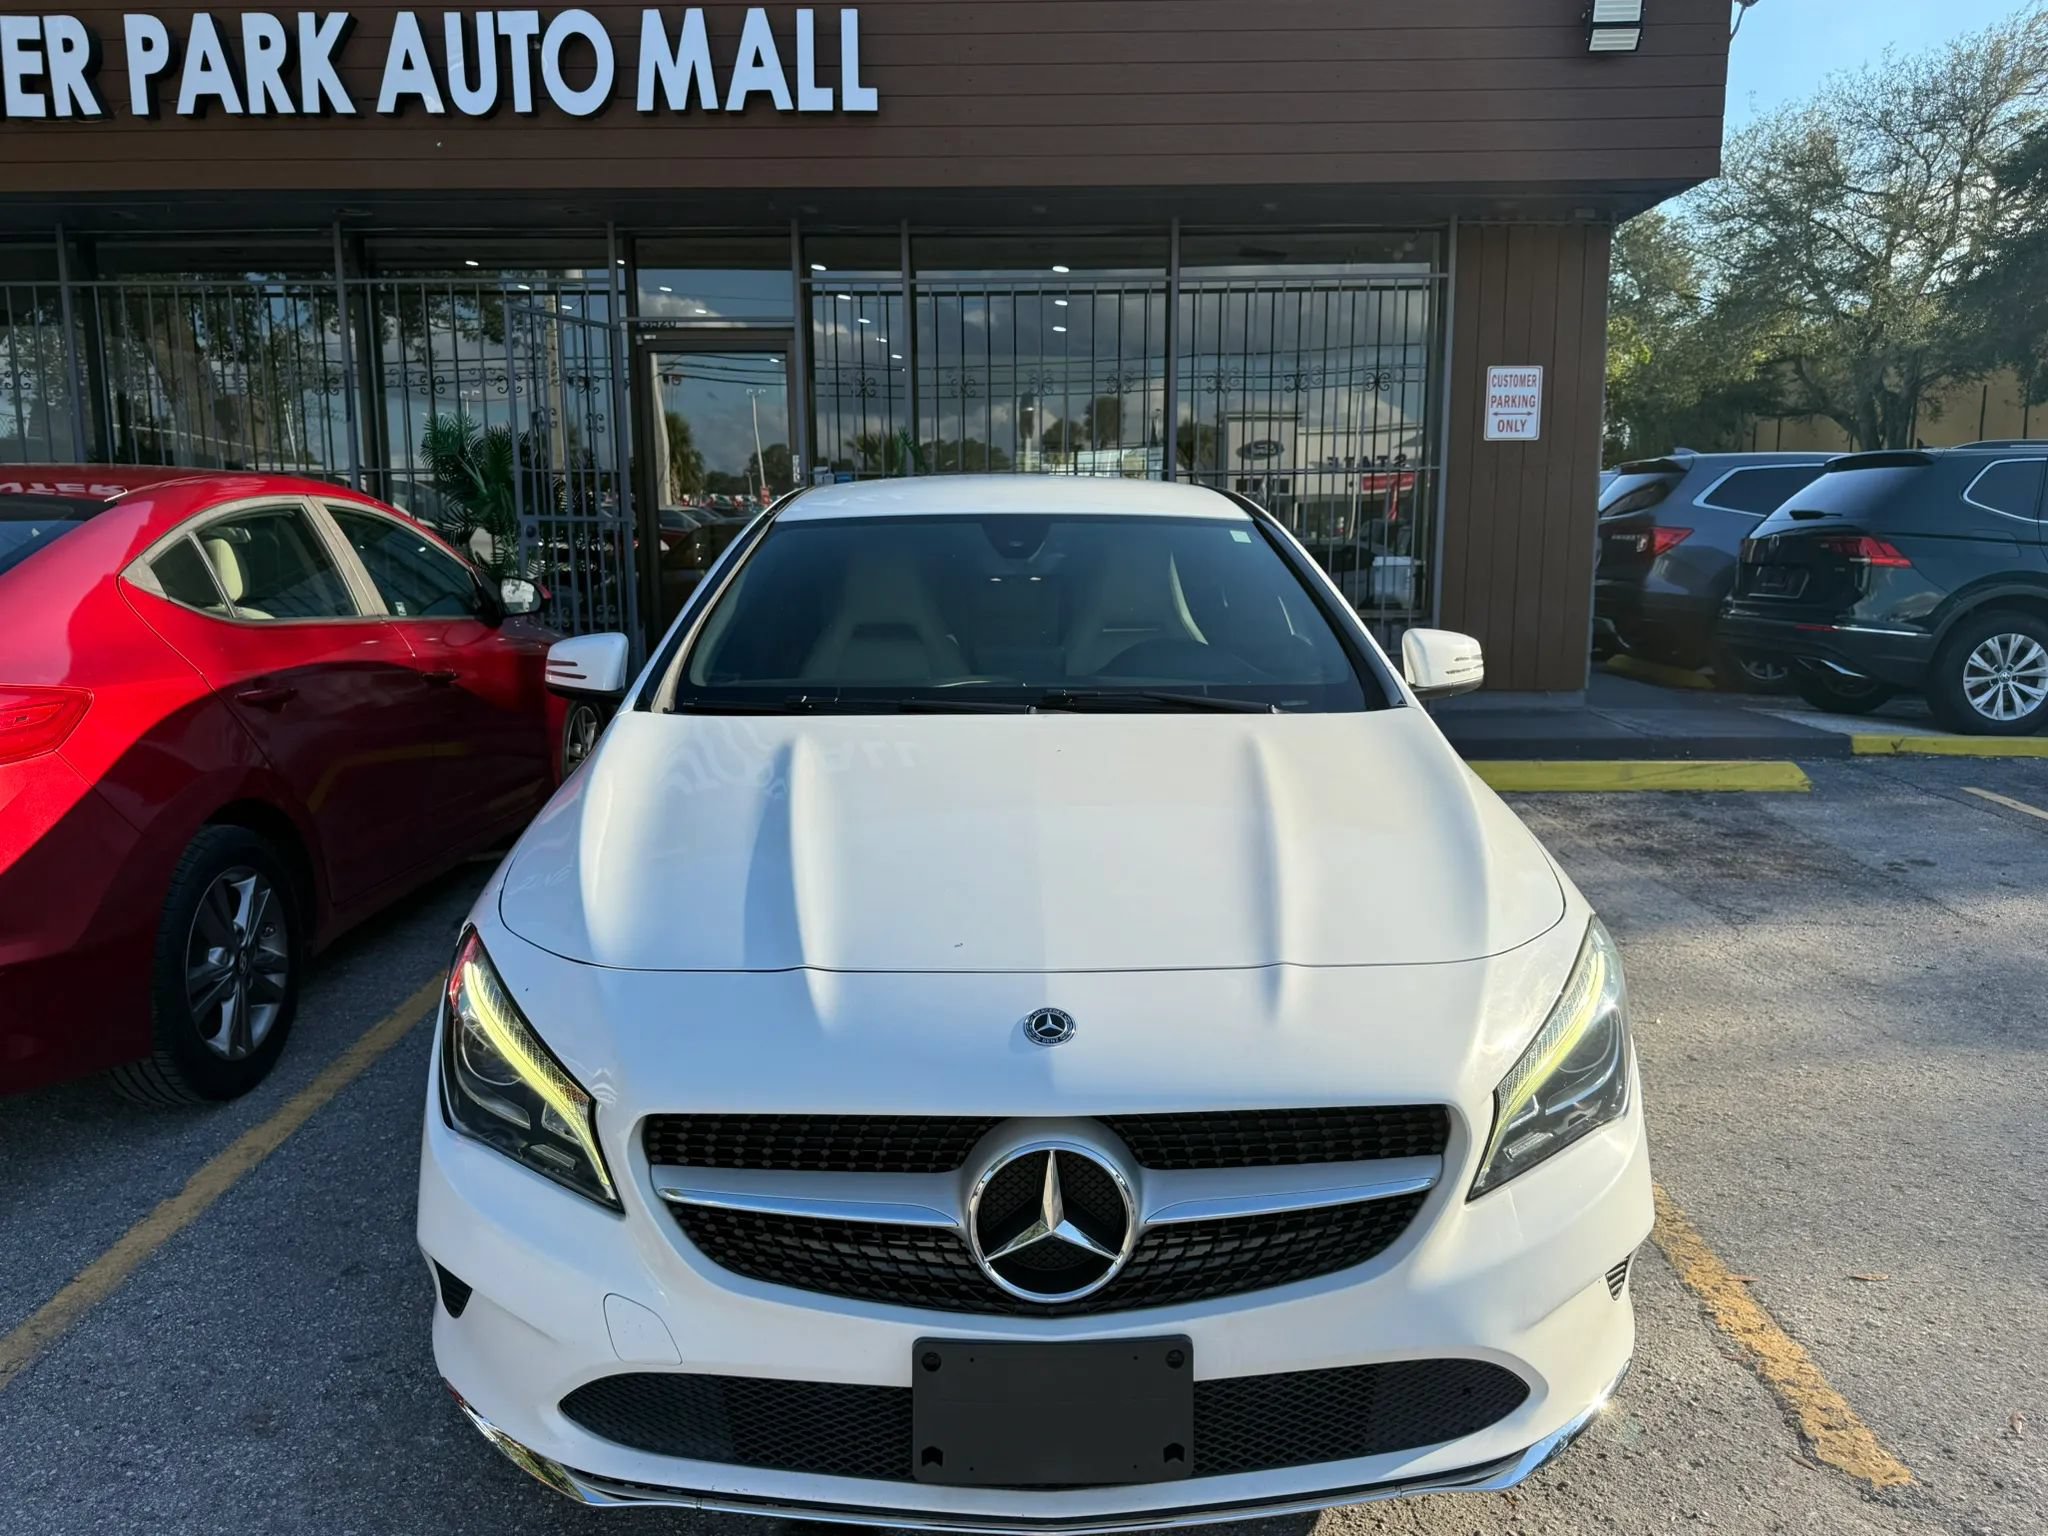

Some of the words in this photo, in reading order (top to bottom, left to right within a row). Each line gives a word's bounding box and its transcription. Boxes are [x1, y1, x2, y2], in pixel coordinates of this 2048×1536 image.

[0, 15, 102, 118] ER
[123, 11, 357, 115] PARK
[376, 8, 615, 116] AUTO
[636, 7, 878, 112] MALL
[1491, 374, 1537, 388] CUSTOMER
[1490, 395, 1536, 408] PARKING
[1497, 419, 1527, 433] ONLY
